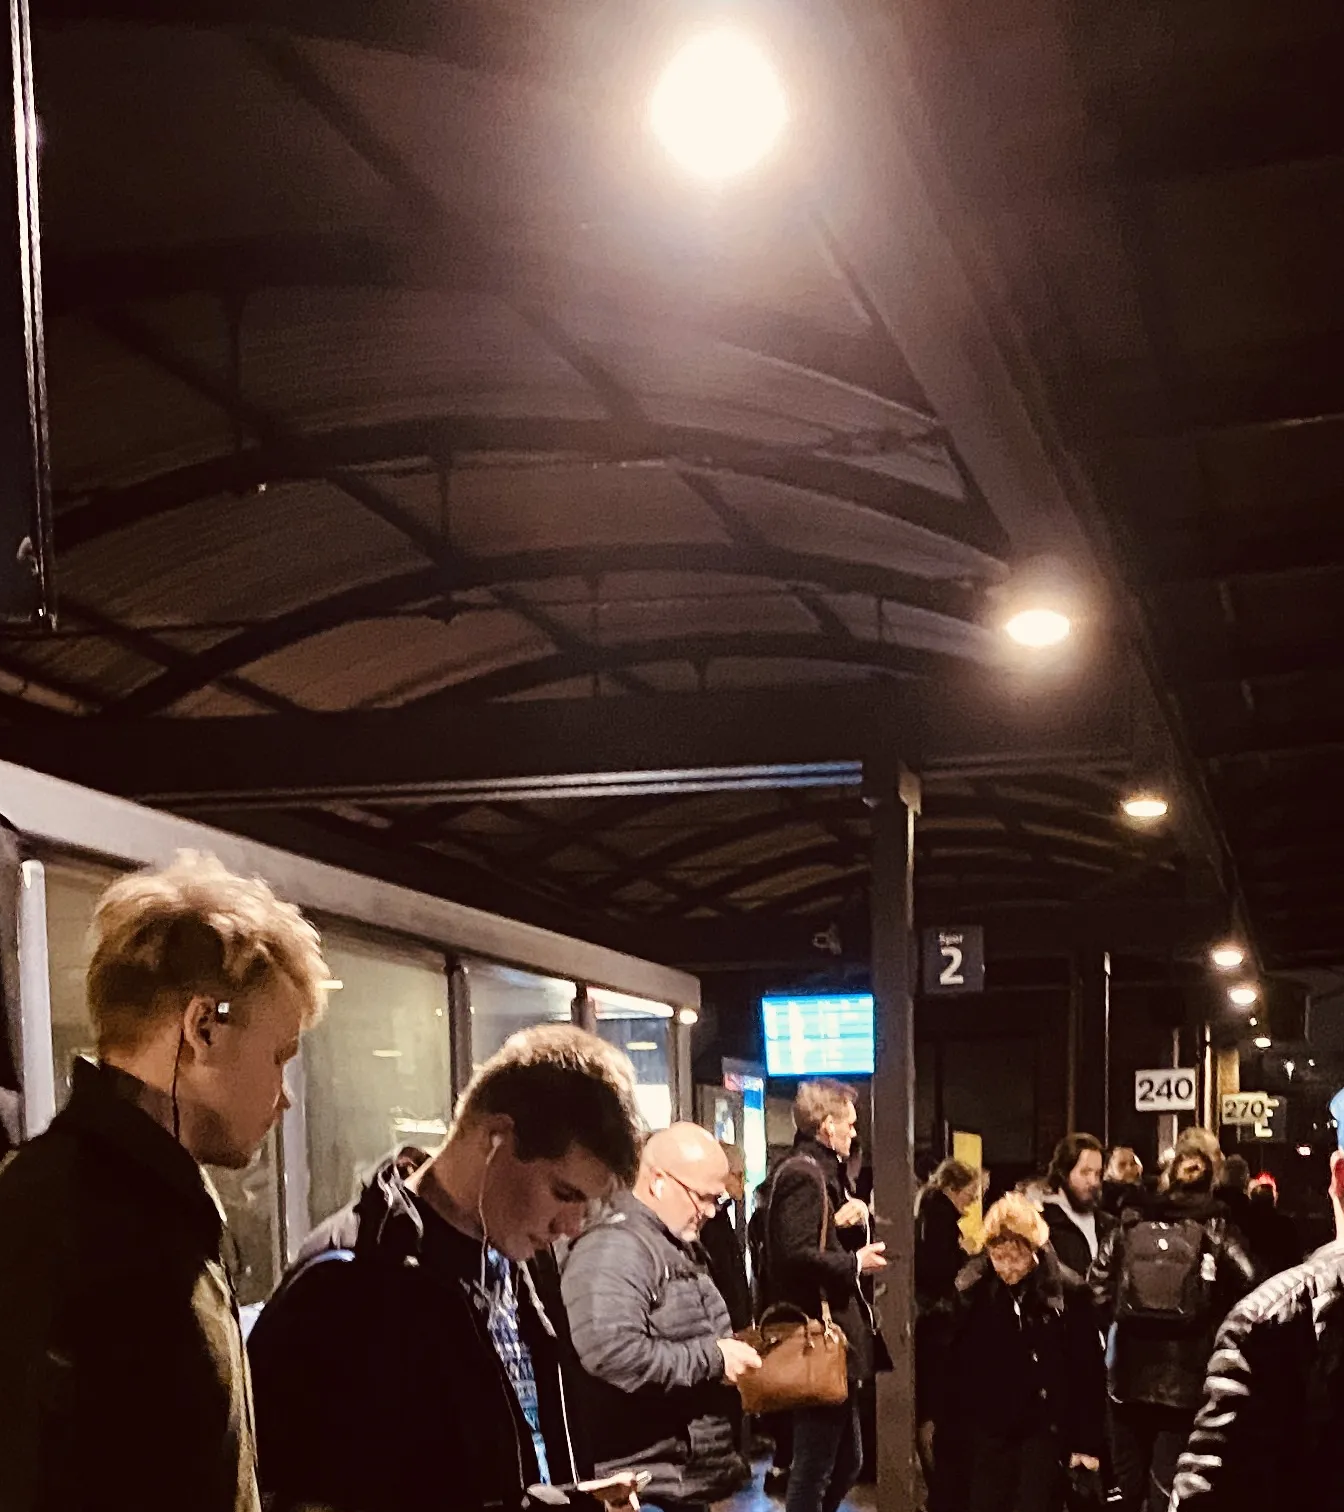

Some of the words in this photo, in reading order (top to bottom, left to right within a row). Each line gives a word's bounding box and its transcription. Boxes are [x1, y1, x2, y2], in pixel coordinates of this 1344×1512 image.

[940, 946, 964, 985] 2
[1138, 1077, 1193, 1102] 240
[1224, 1100, 1265, 1119] 270
